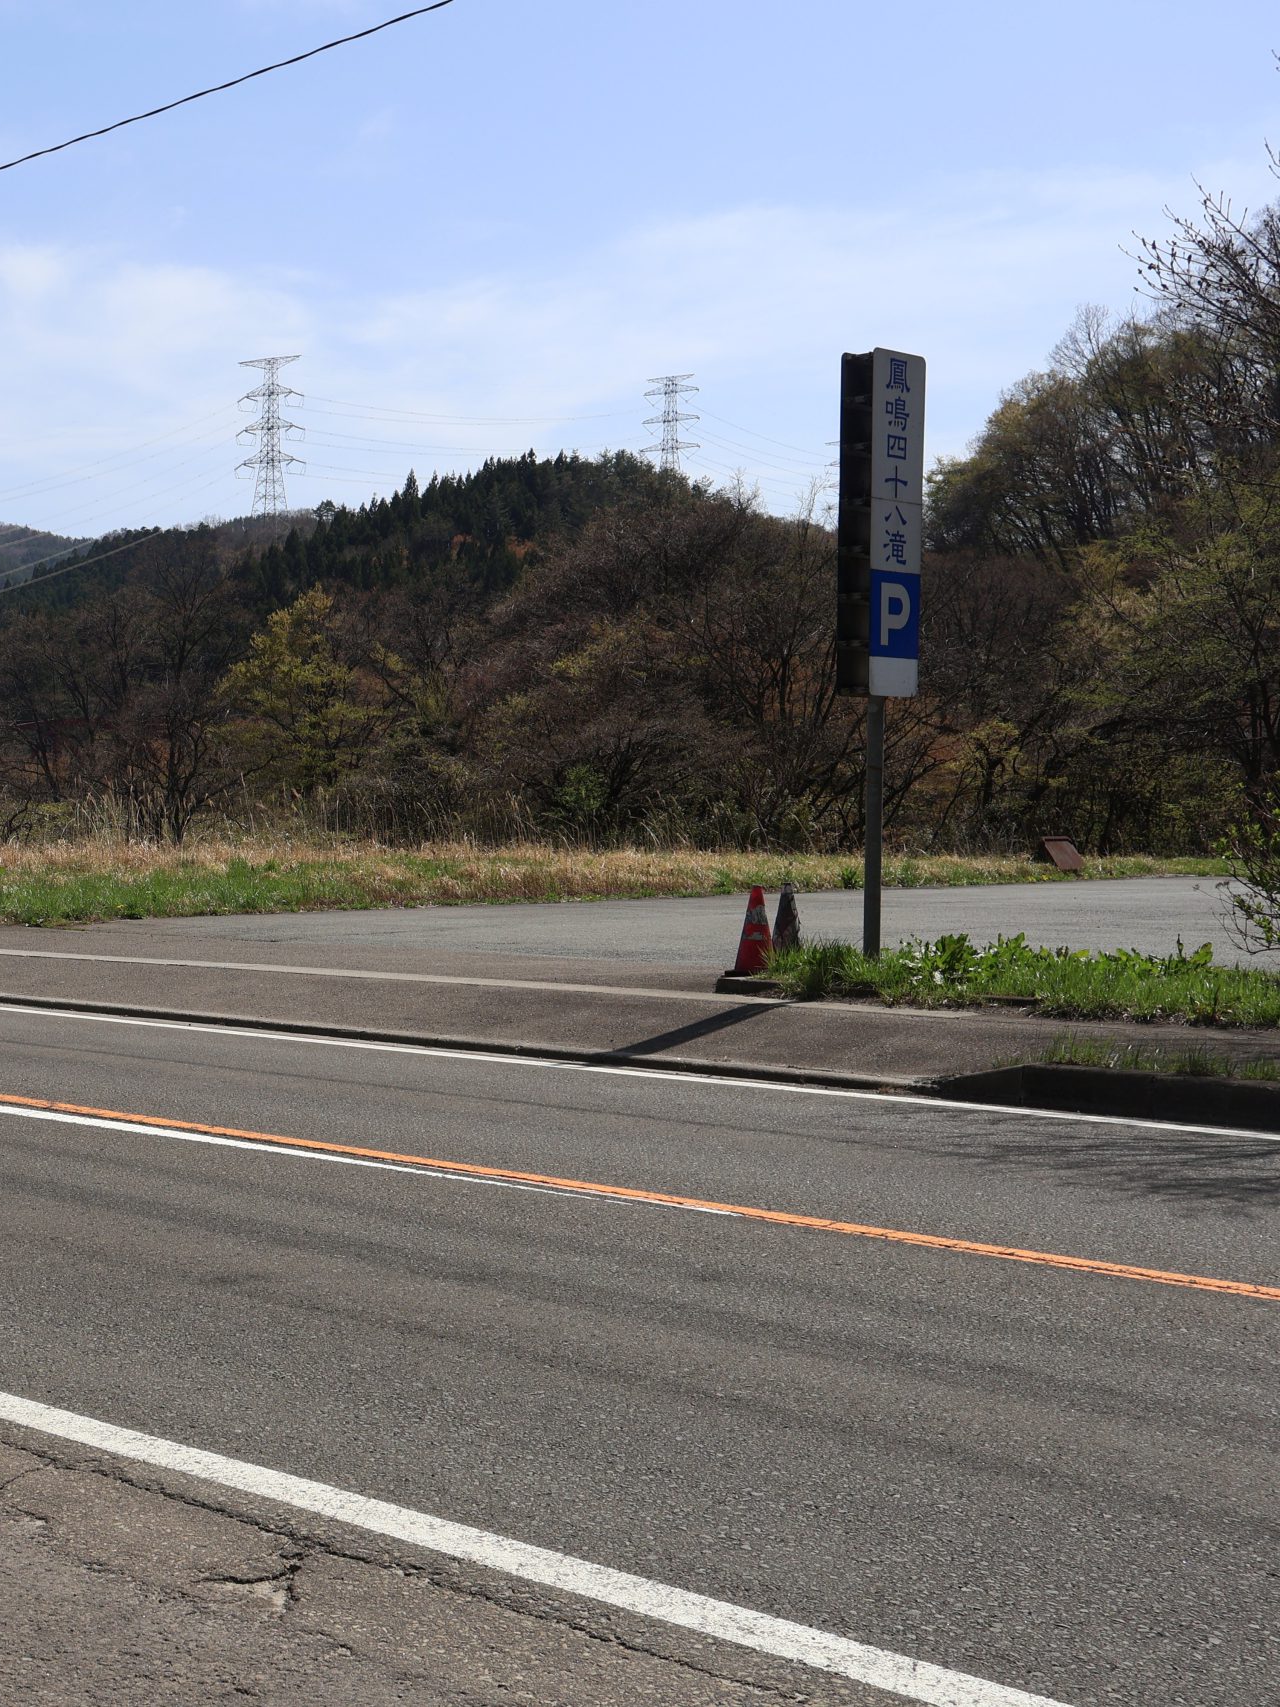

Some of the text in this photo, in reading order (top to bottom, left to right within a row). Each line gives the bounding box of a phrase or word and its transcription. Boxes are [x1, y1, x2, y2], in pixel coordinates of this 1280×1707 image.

[883, 358, 911, 565] 鳳鳴四十八滝
[880, 582, 911, 646] P
